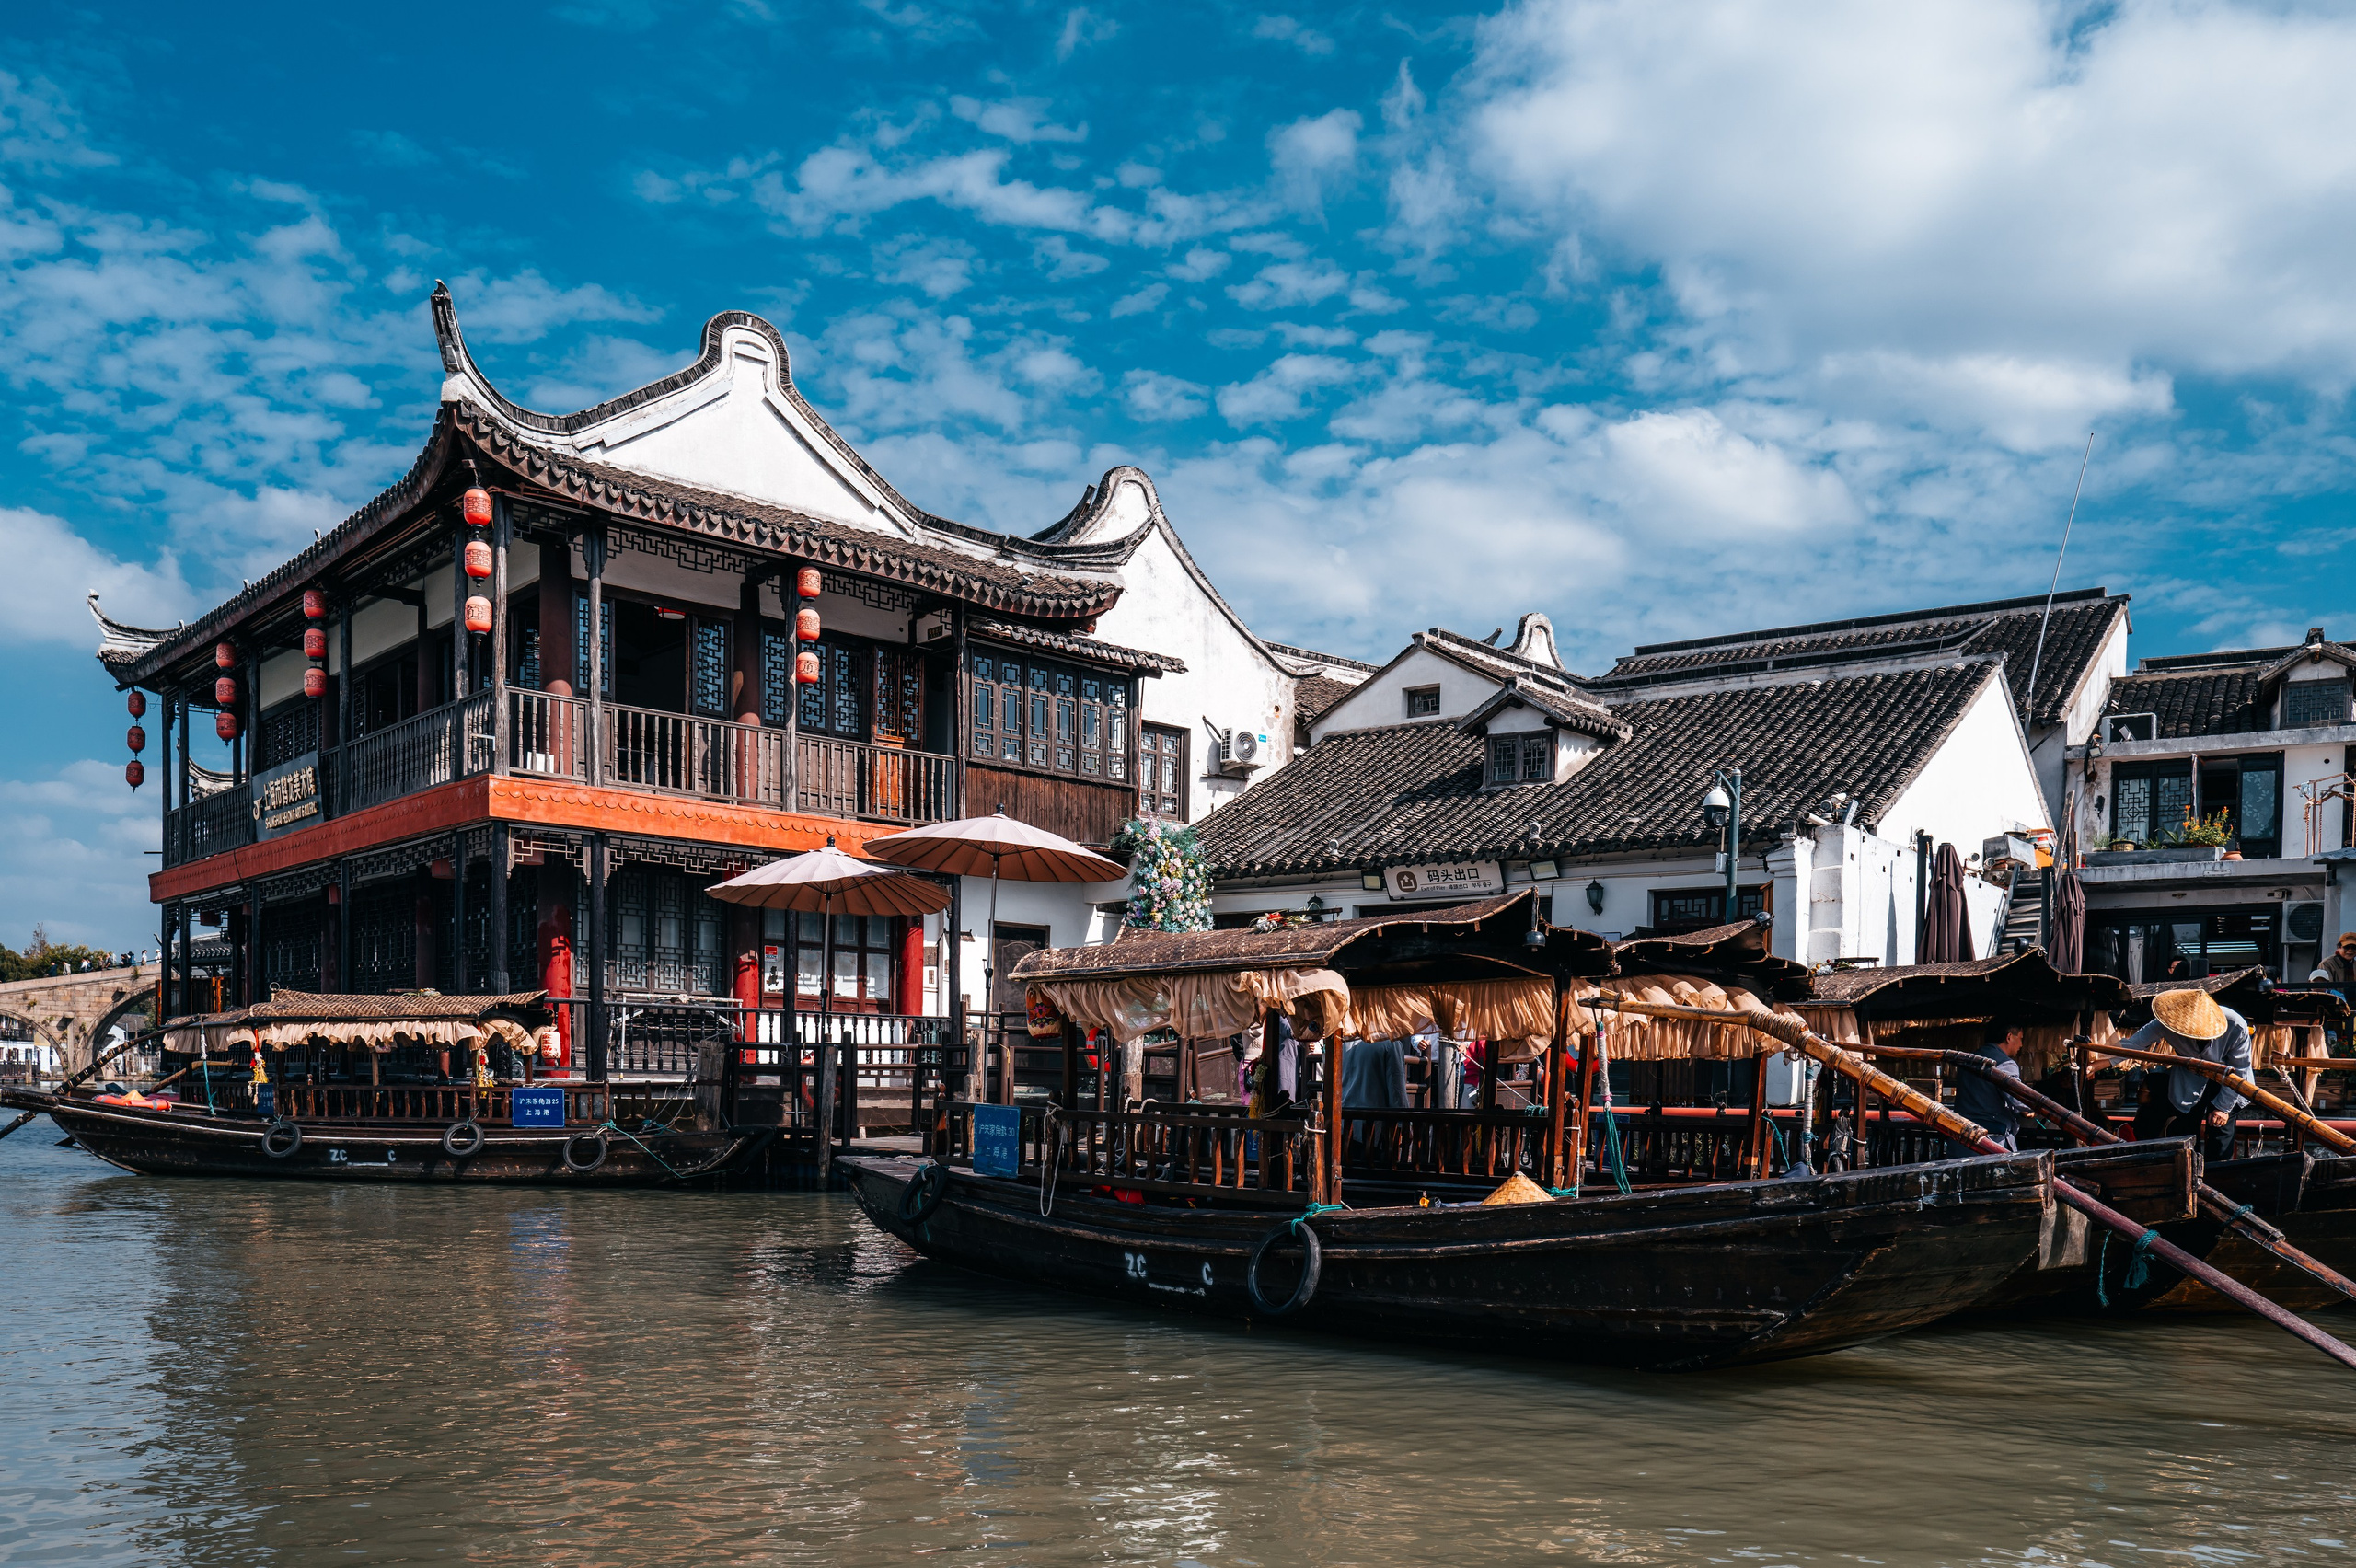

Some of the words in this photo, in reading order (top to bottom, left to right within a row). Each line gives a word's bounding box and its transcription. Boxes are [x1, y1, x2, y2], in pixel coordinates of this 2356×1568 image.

[1426, 868, 1480, 882] 码头出口
[329, 1148, 348, 1162] ZC
[387, 1149, 397, 1162] C
[1124, 1251, 1147, 1278] ZC
[1202, 1262, 1214, 1286] C
